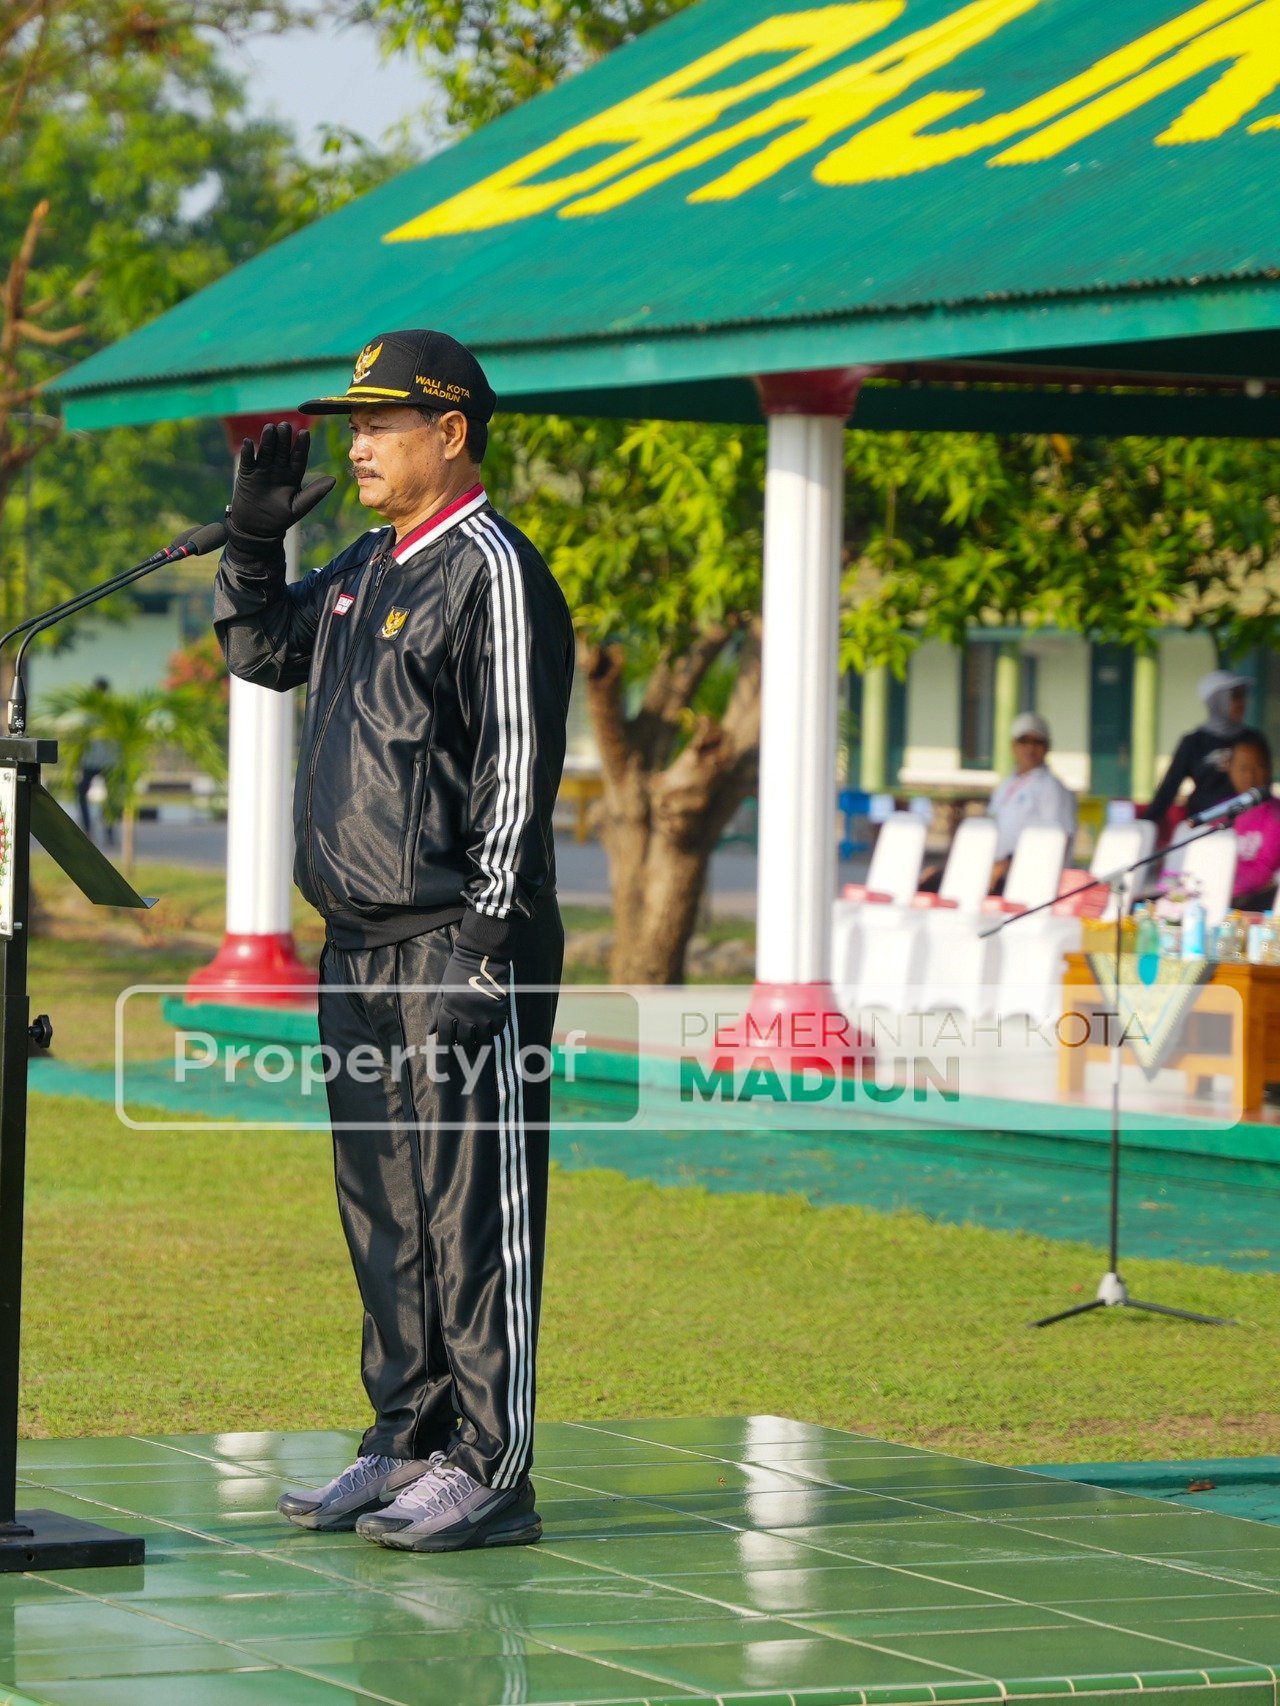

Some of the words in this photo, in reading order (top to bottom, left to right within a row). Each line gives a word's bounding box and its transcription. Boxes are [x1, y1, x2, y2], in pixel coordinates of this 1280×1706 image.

[415, 374, 441, 389] WALI
[446, 383, 470, 399] KOTA
[422, 385, 461, 403] MADIUN
